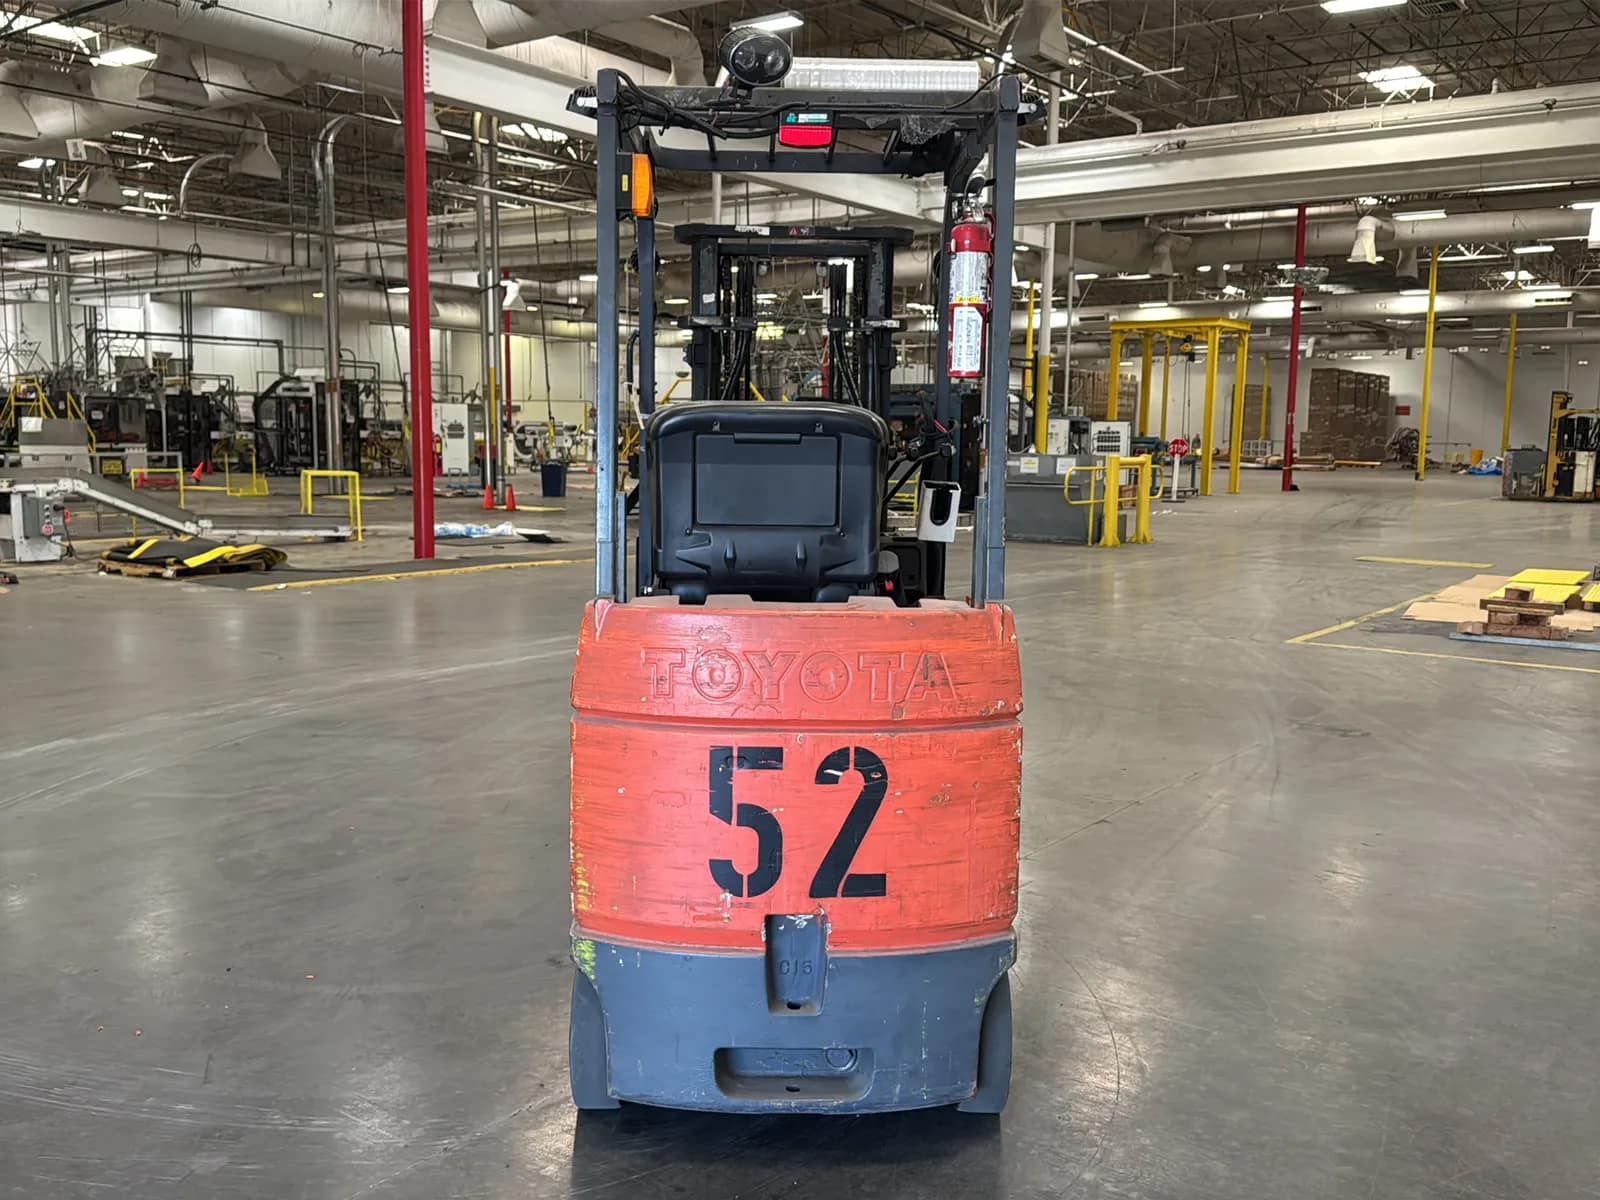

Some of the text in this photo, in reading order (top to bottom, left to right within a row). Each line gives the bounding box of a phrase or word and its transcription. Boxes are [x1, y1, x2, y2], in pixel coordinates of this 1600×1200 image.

[1168, 444, 1188, 454] STOP
[641, 646, 958, 703] TOYOTA
[709, 745, 888, 898] 52
